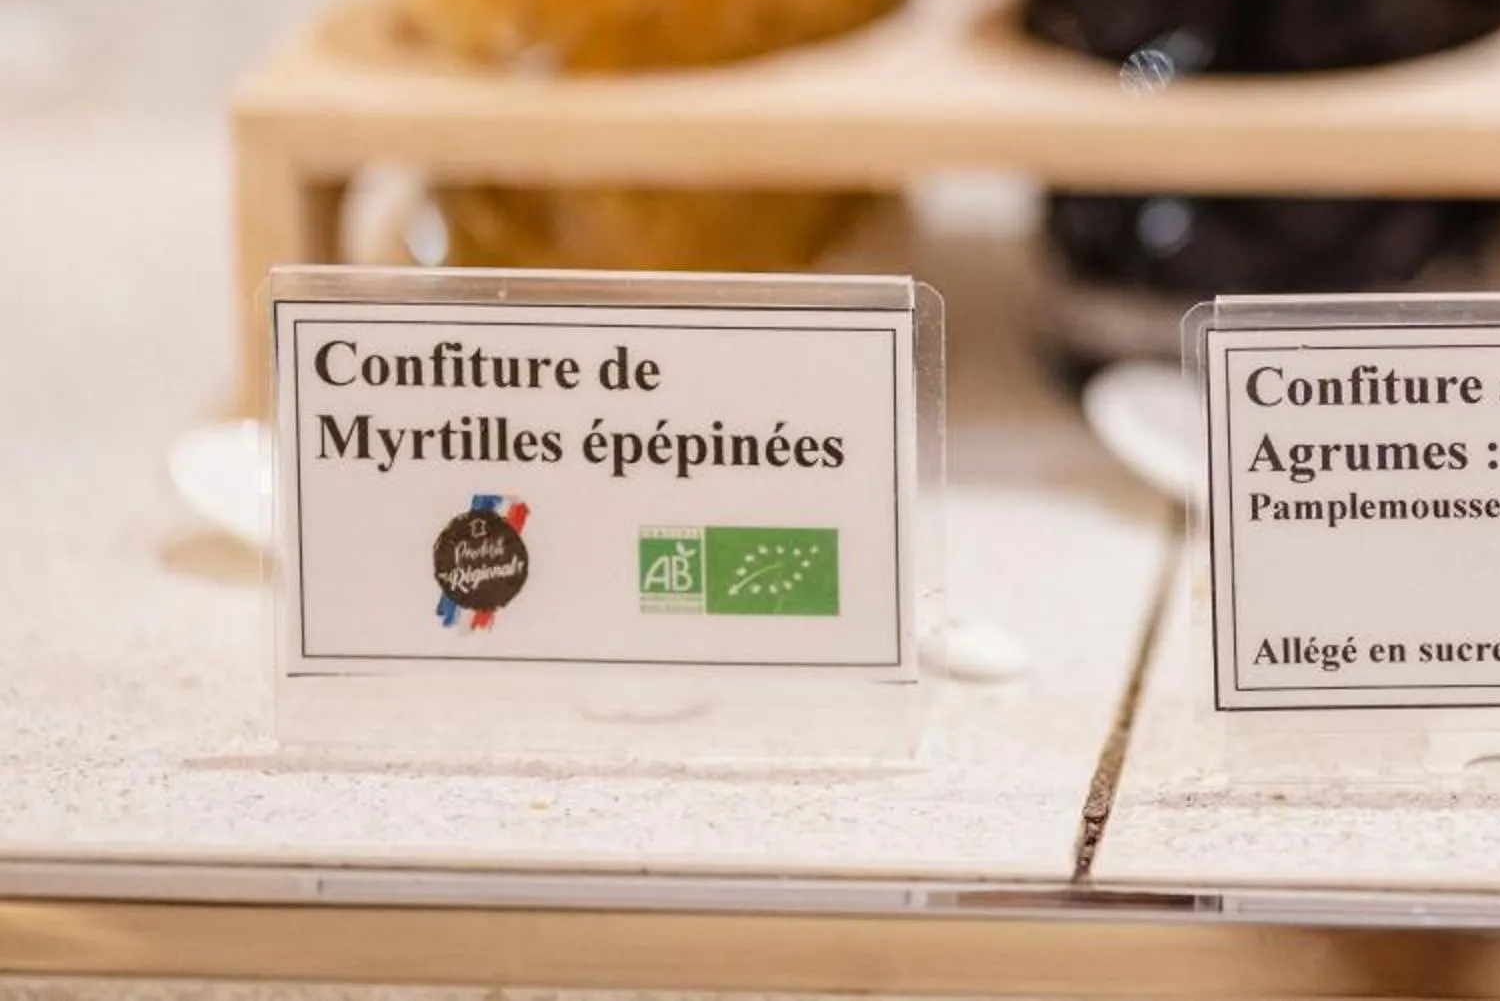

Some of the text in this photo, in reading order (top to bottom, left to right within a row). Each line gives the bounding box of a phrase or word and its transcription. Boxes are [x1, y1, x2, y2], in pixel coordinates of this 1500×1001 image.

[313, 339, 662, 392] Confiture de
[1245, 363, 1484, 407] Confiture
[316, 413, 846, 480] Myrtilles épépinées
[1247, 433, 1469, 484] Agrumes
[644, 555, 693, 592] AB
[1253, 635, 1359, 672] Allégé
[1368, 644, 1408, 664] en
